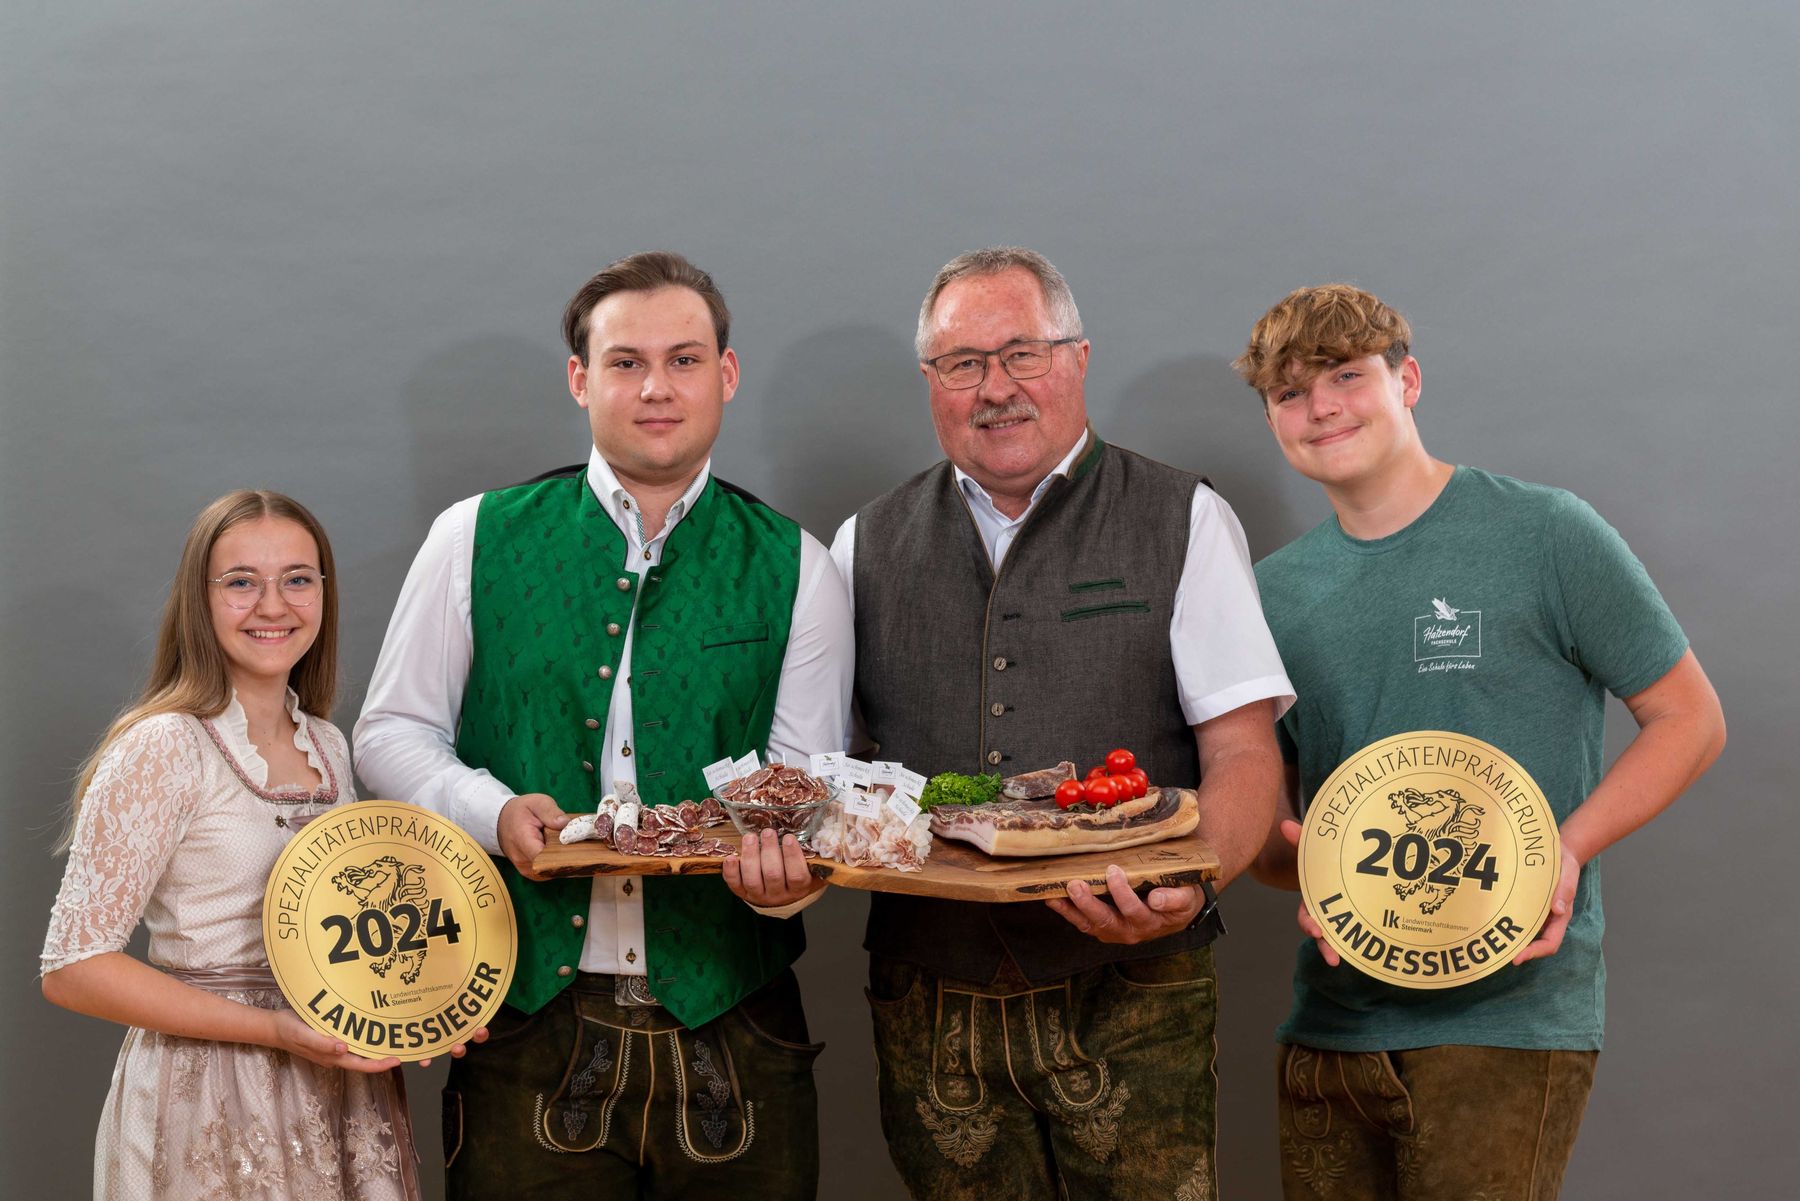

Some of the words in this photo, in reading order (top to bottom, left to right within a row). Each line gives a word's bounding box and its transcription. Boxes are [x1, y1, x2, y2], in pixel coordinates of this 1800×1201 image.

[1423, 624, 1471, 646] Hatzendorf
[1458, 660, 1476, 670] Leben
[1317, 745, 1545, 867] SPEZIALITÄTENPRÄMIERUNG
[278, 815, 497, 940] SPEZIALITÄTENPRÄMIERUNG
[1355, 828, 1500, 891] 2024
[320, 898, 462, 965] 2024
[1318, 892, 1525, 977] LANDESSIEGER
[1401, 923, 1433, 934] Steiermark
[1402, 916, 1470, 932] Landwirtschaftskammer
[307, 961, 502, 1049] LANDESSIEGER
[390, 983, 454, 999] Landwirtschaftskammer
[391, 995, 422, 1006] Steiermark
